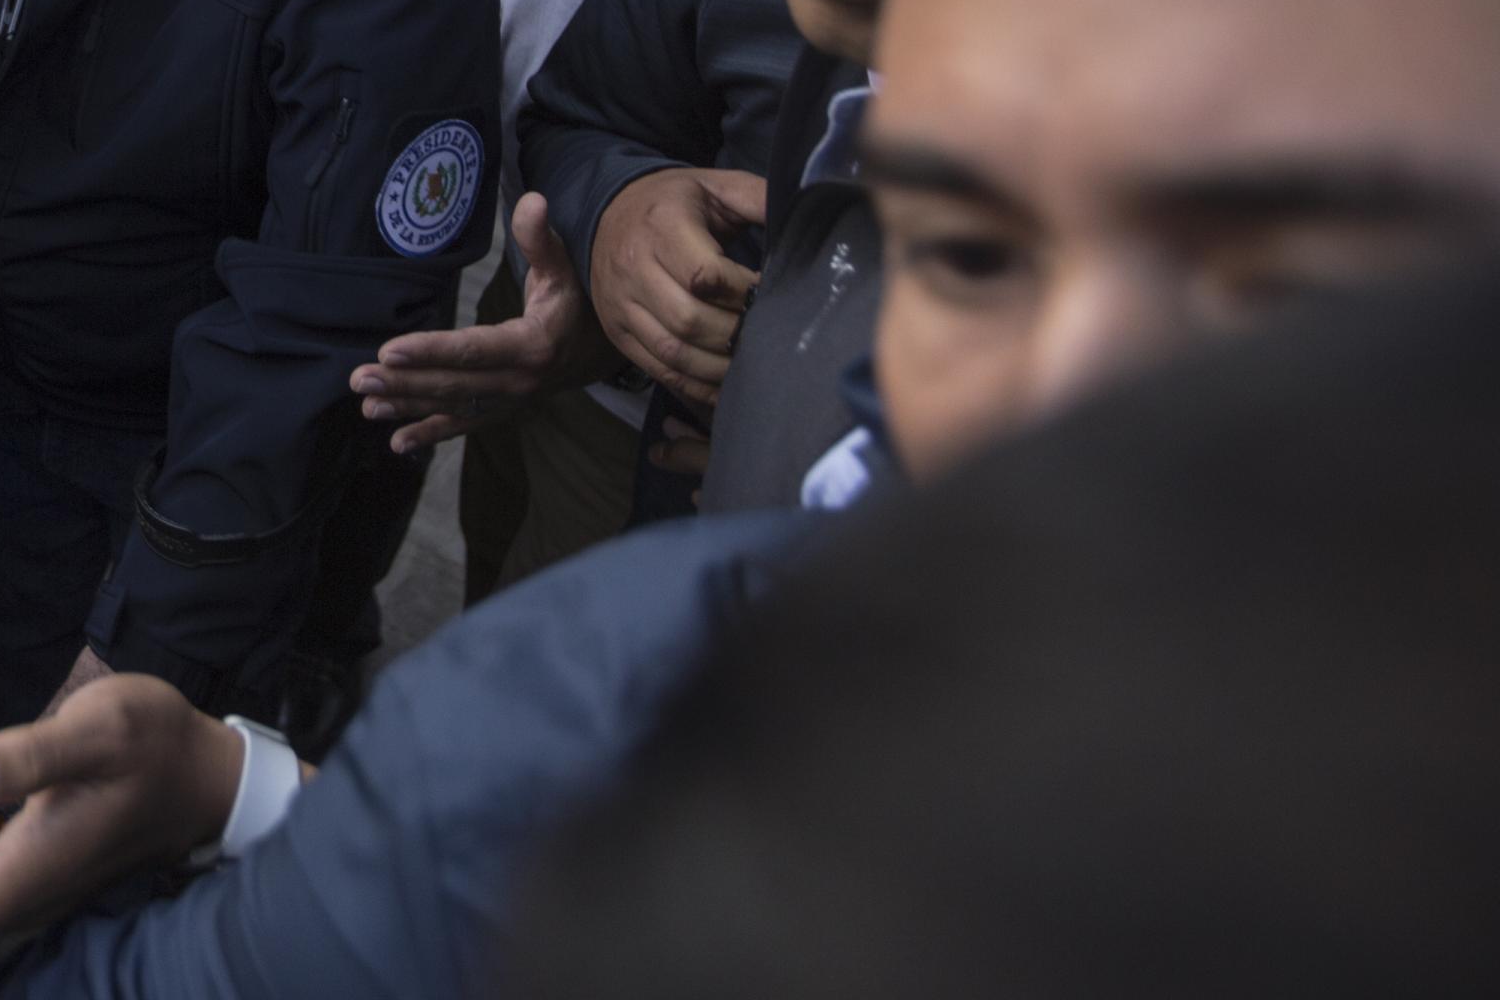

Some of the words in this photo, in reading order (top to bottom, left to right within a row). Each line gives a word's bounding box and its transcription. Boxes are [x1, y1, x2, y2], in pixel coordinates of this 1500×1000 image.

[393, 130, 476, 185] PRESIDENTE
[388, 210, 404, 229] DE
[399, 226, 414, 244] LA
